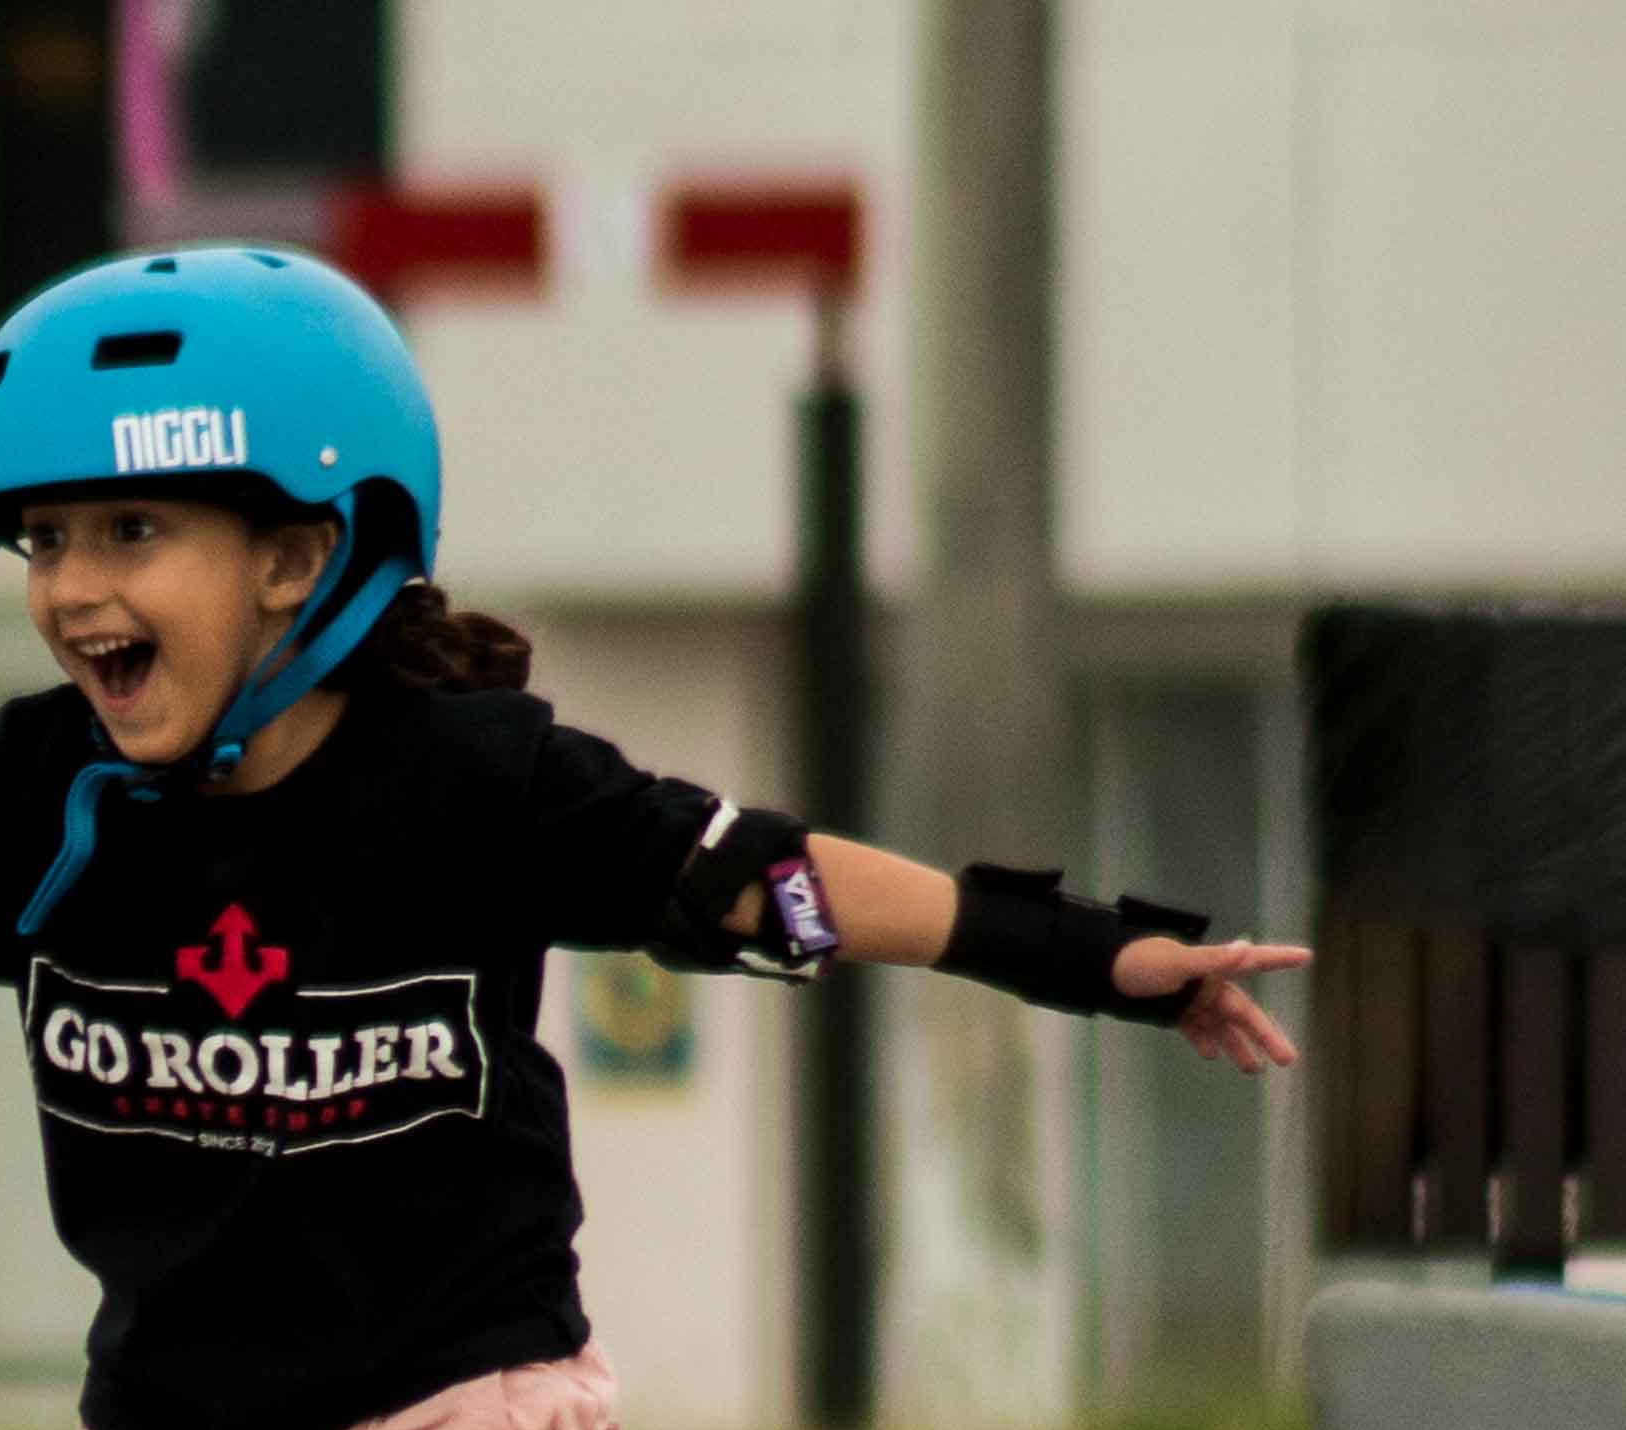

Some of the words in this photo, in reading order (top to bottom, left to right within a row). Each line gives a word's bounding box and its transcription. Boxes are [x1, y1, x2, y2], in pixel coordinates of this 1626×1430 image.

[112, 407, 247, 473] NIGGLI
[785, 871, 826, 940] FILA
[43, 1008, 130, 1084] GO
[141, 1021, 466, 1101] ROLLER
